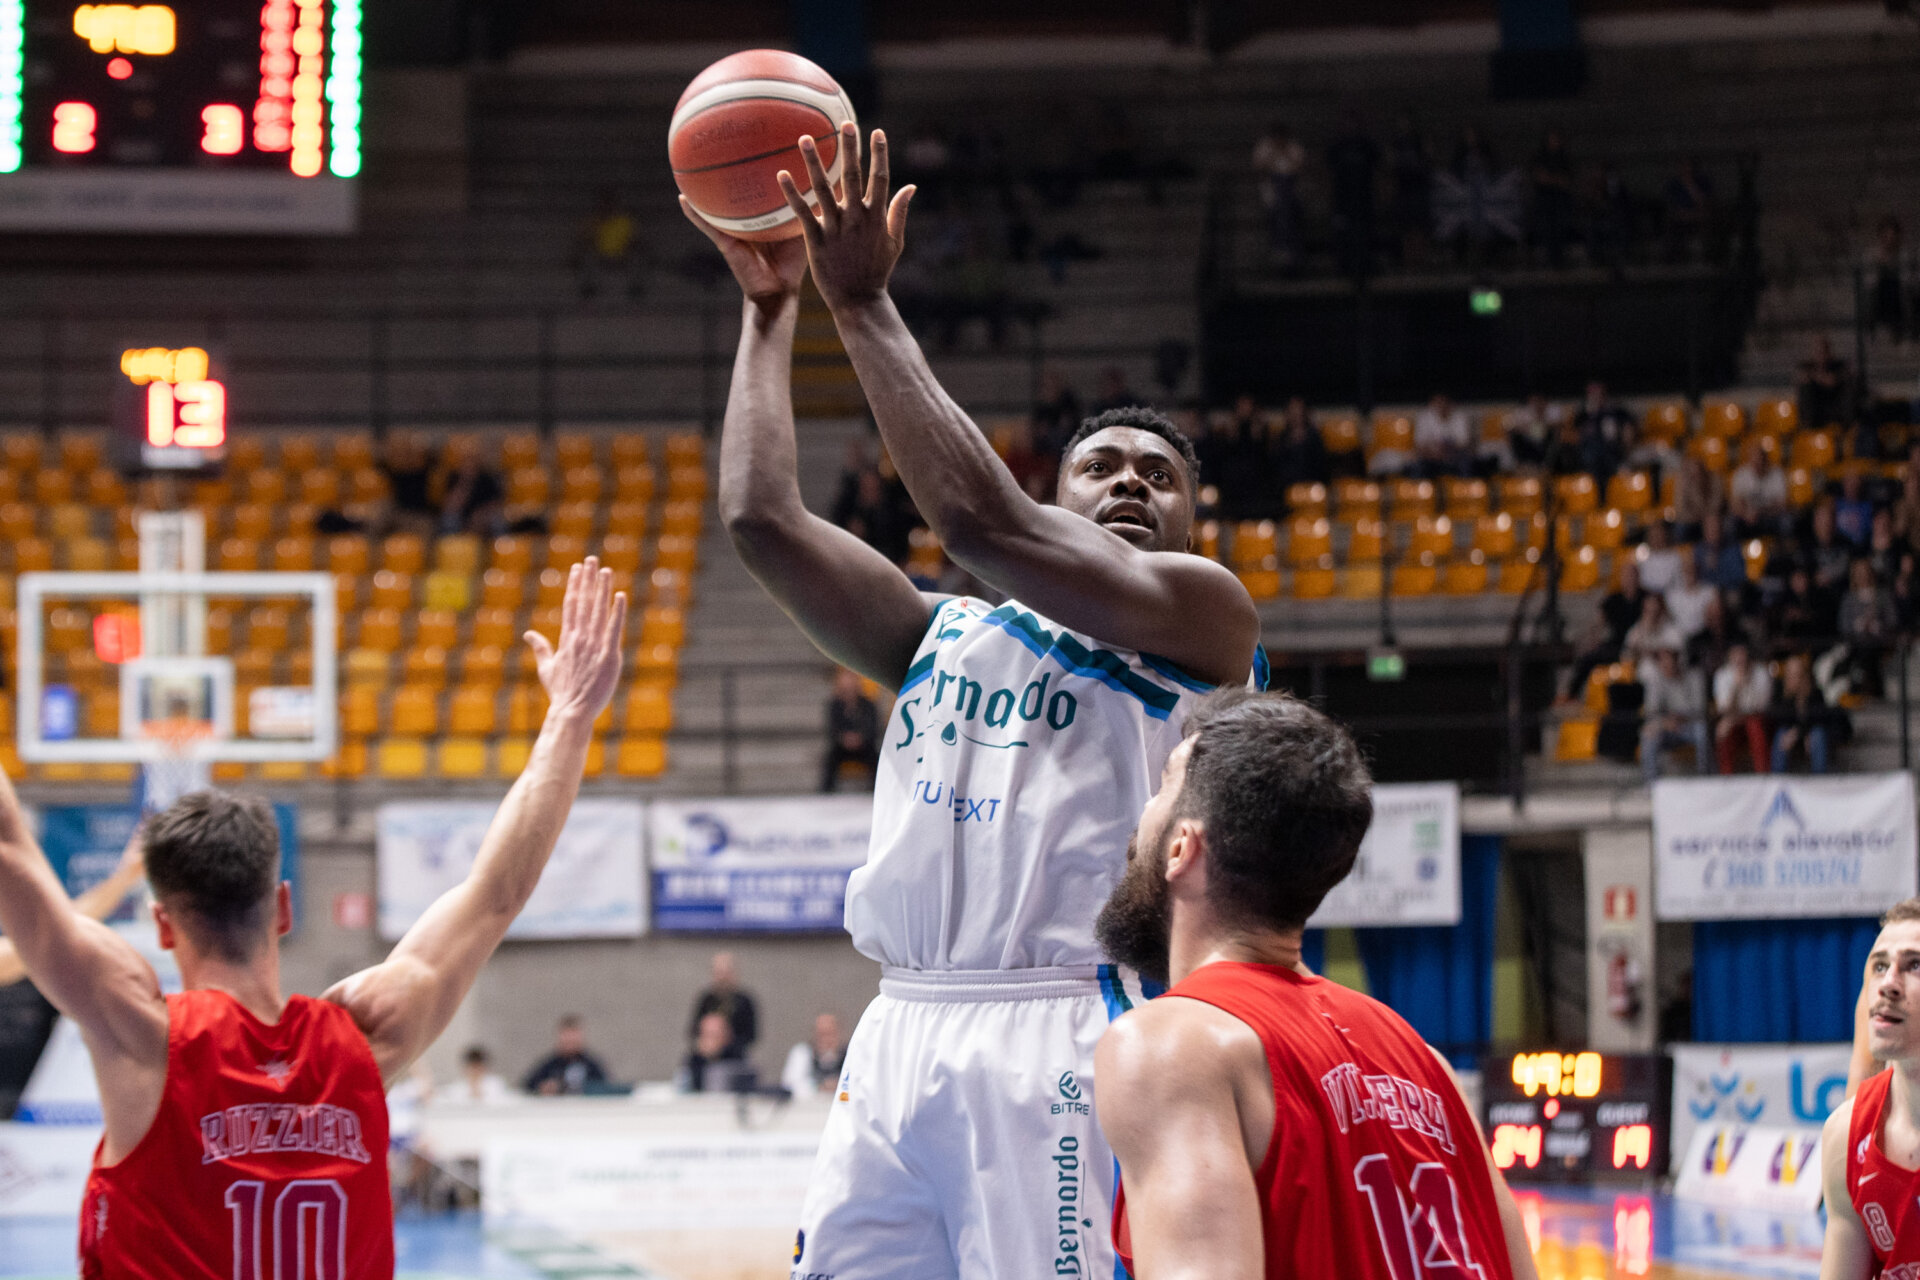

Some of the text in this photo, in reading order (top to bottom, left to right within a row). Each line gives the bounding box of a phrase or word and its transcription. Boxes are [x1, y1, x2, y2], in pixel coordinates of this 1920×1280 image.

[148, 379, 226, 448] 13
[200, 1103, 371, 1165] RUZZIER
[1050, 1102, 1090, 1116] BITRE
[225, 1180, 348, 1280] 10
